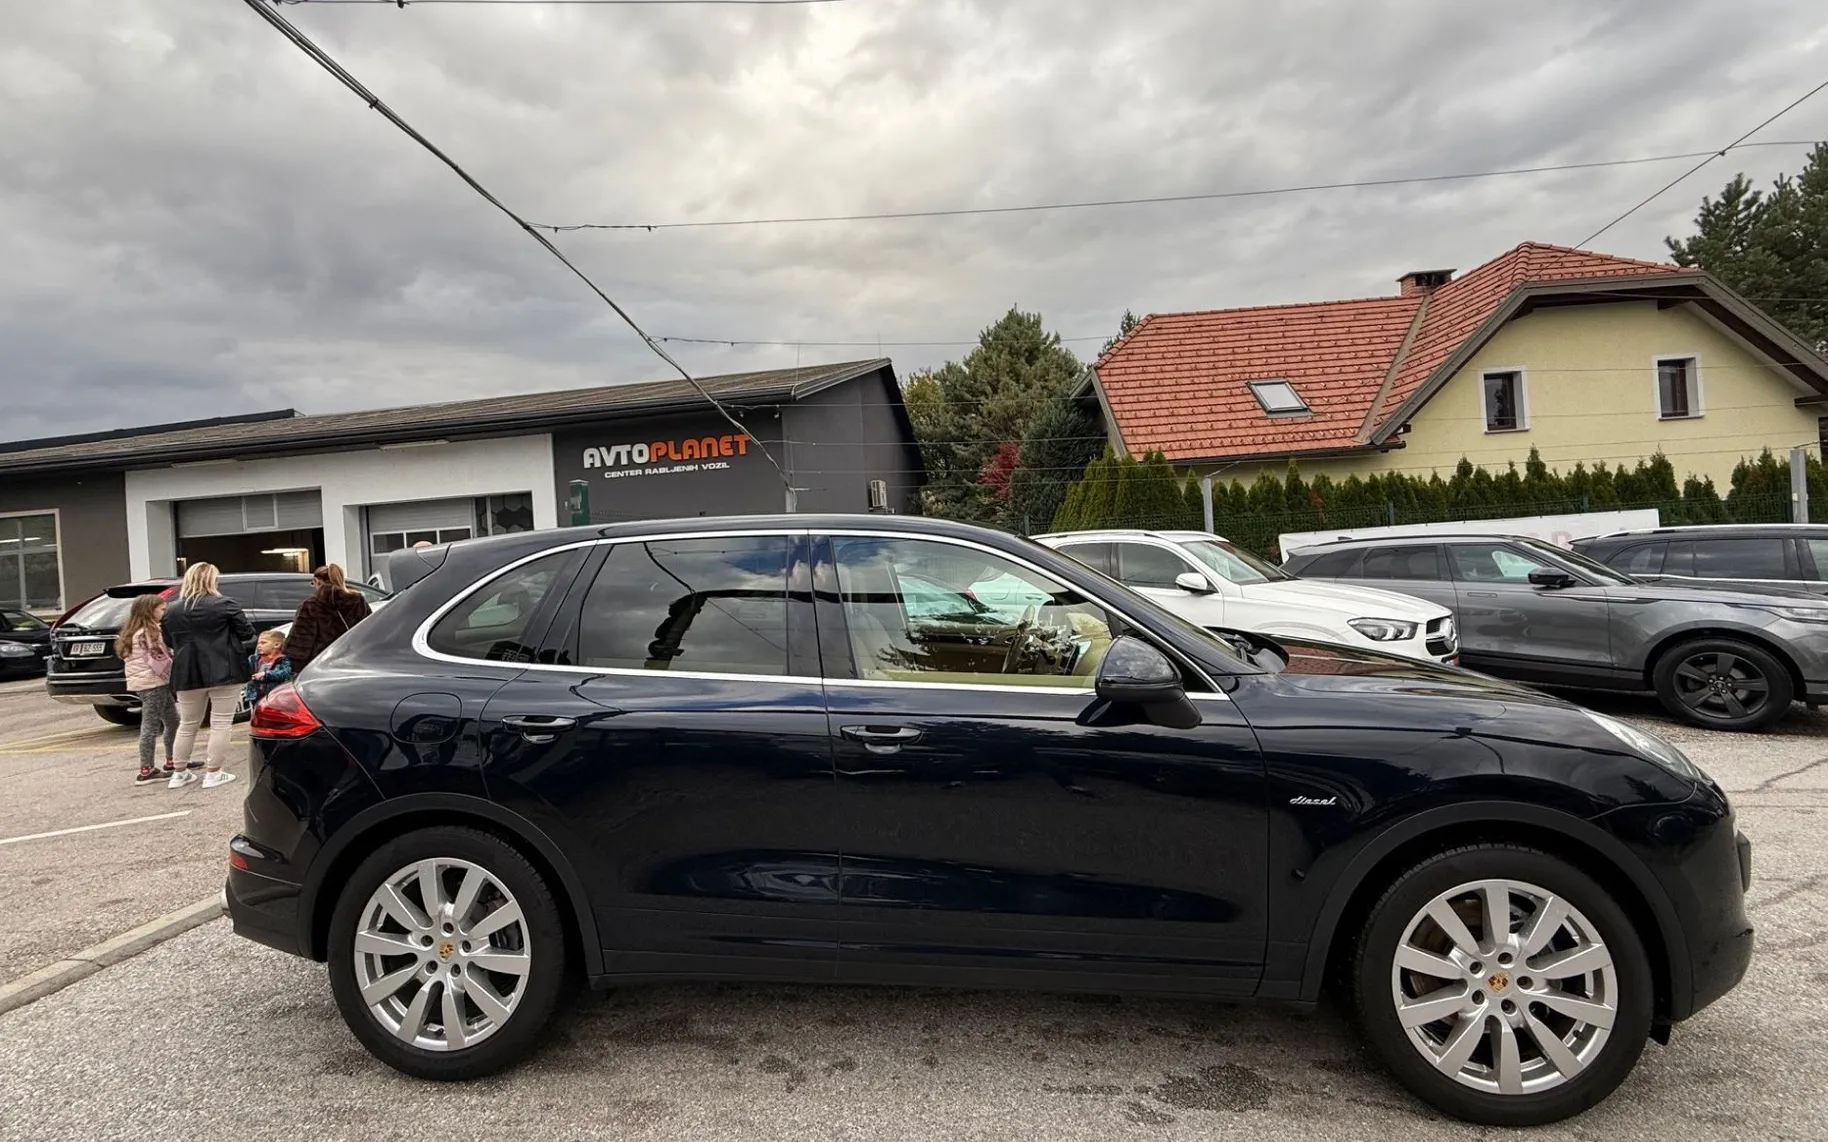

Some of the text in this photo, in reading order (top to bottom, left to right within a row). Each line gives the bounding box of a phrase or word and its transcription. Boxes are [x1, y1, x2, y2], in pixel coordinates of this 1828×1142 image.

[583, 433, 750, 468] AVTOPLANET
[604, 462, 730, 479] CENTER RABLJENIH VOZIL
[1289, 795, 1337, 806] diesel
